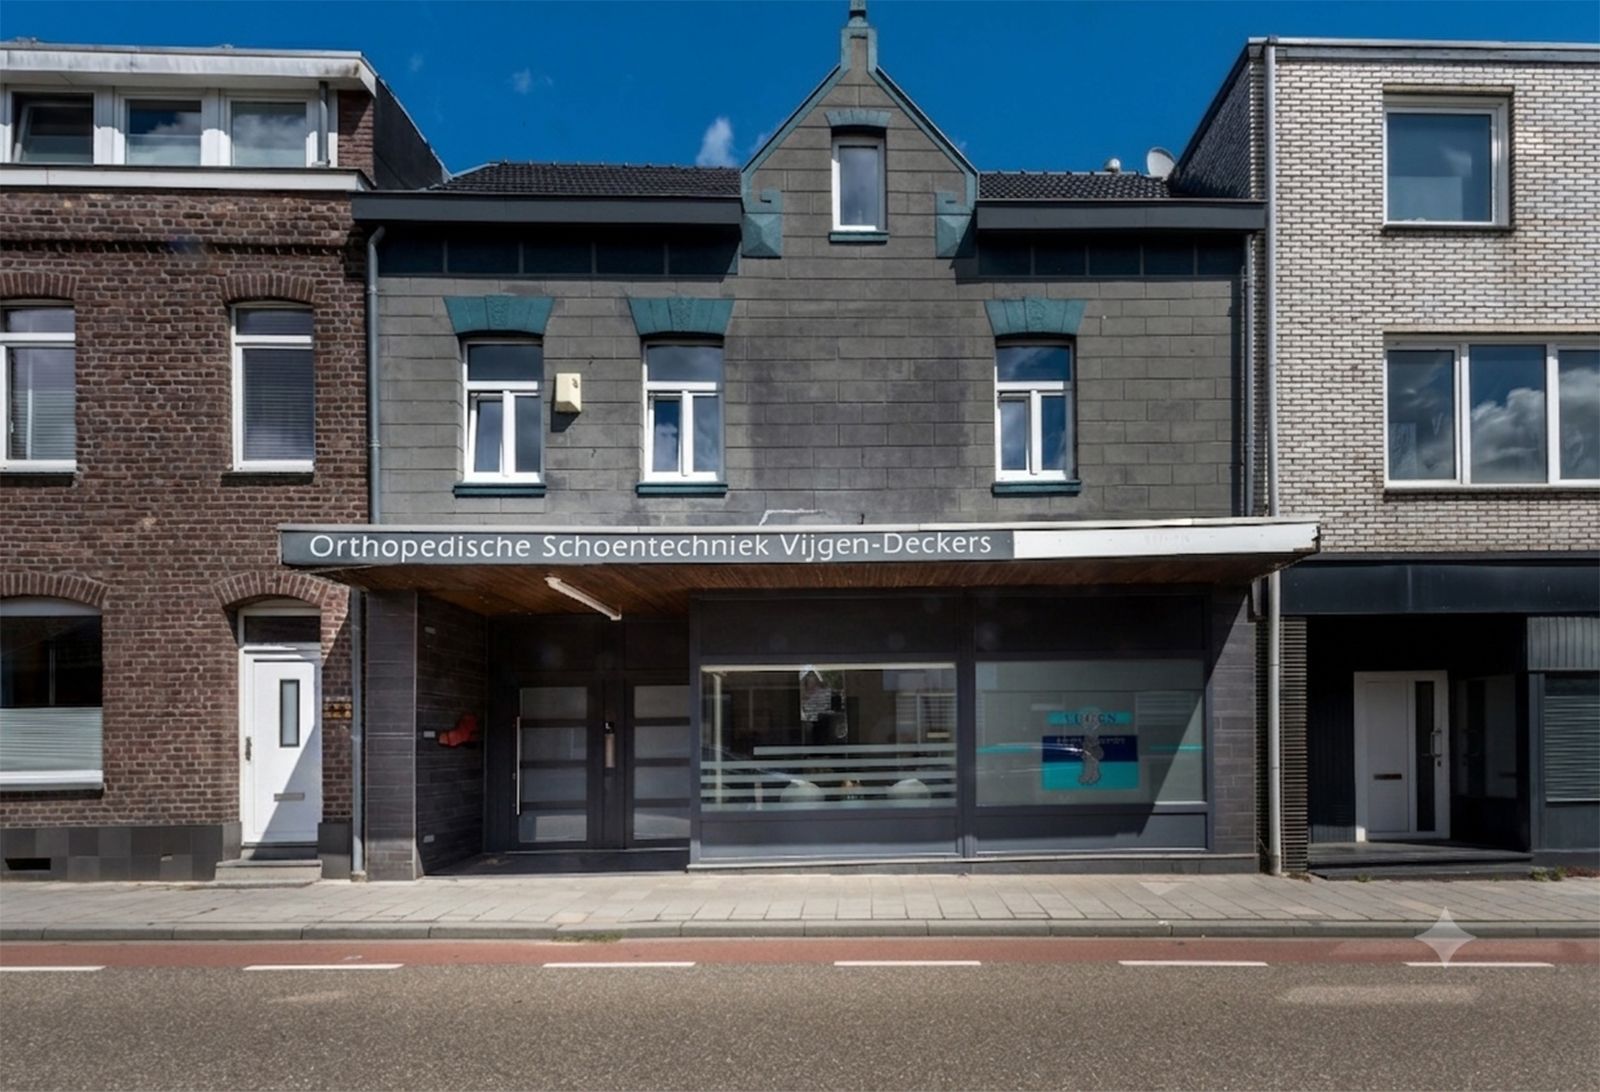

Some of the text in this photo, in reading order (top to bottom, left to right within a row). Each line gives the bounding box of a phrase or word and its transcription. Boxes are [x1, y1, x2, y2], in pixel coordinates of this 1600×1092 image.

[309, 532, 992, 563] Orthopedische Schoentechniek Vijgen-Deckers
